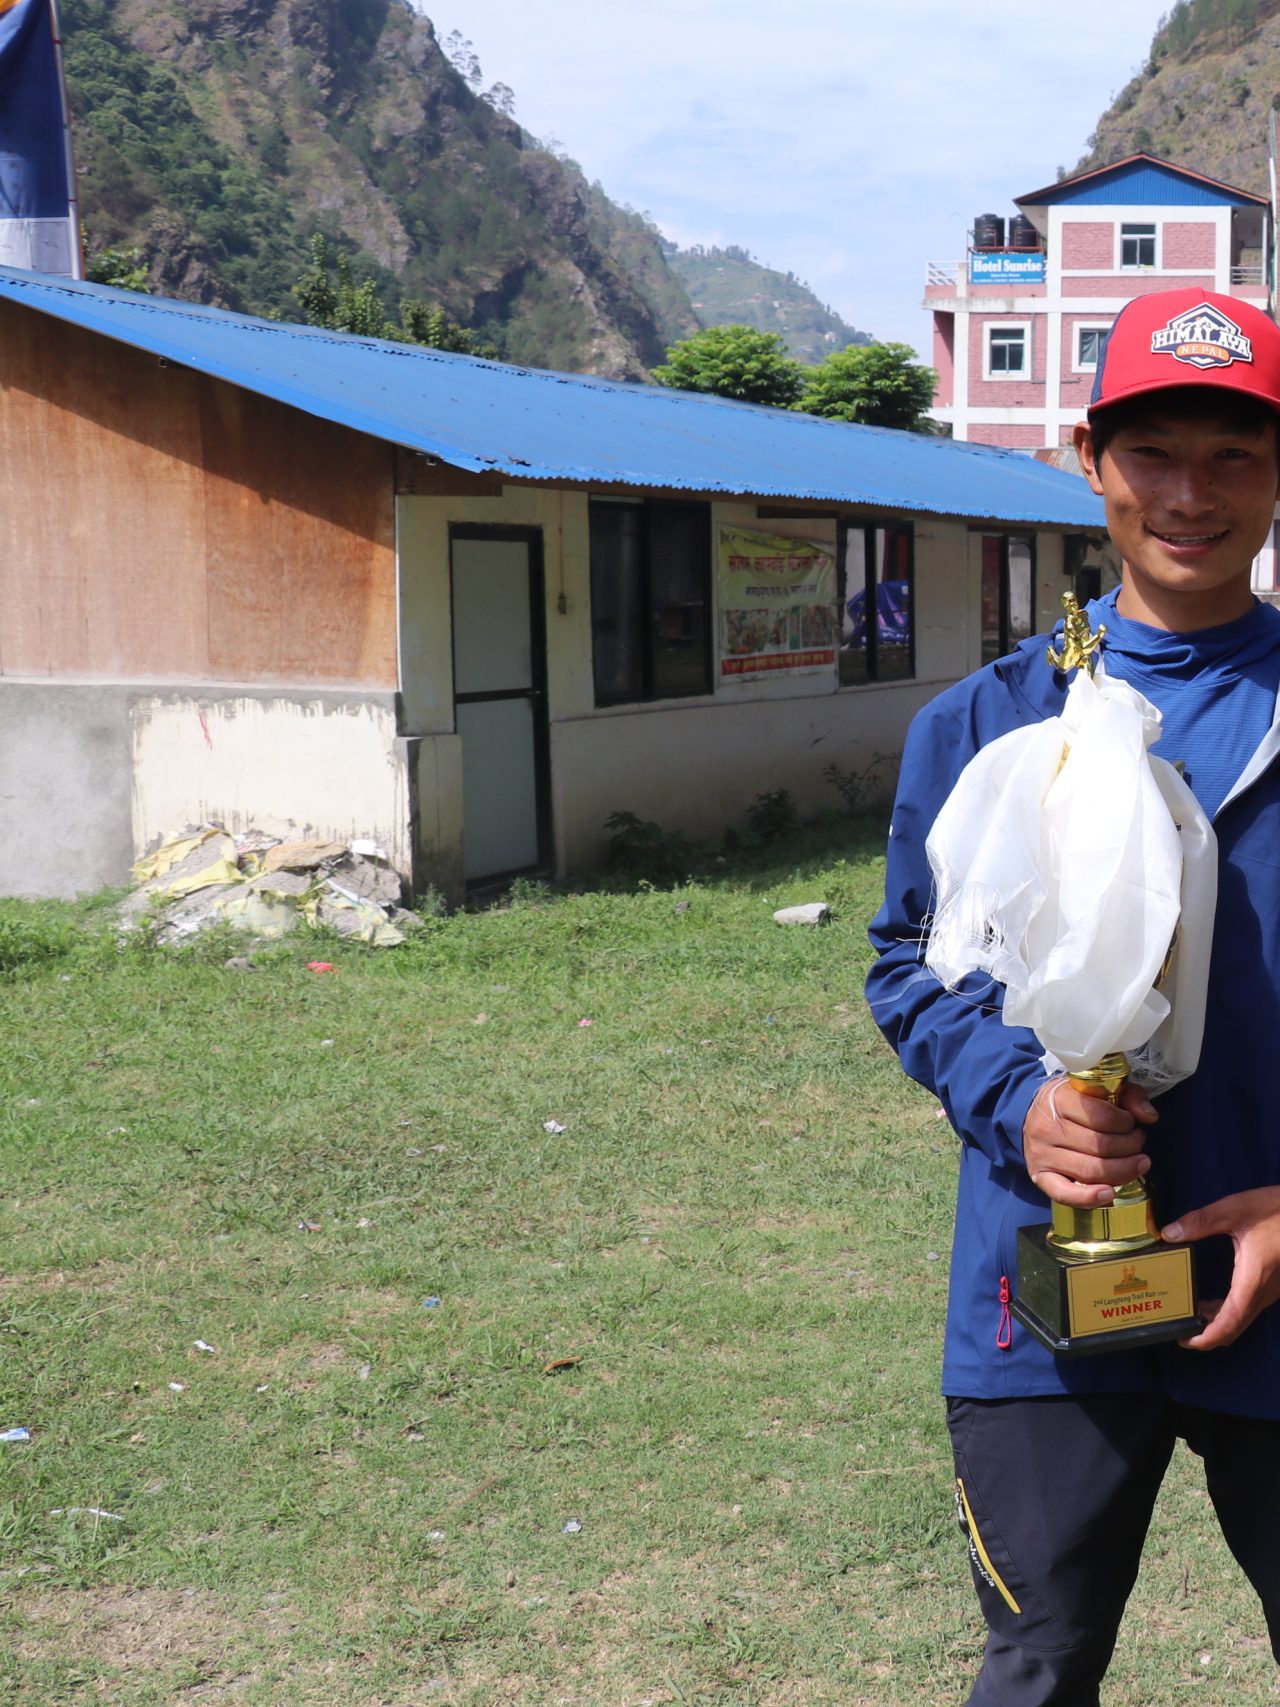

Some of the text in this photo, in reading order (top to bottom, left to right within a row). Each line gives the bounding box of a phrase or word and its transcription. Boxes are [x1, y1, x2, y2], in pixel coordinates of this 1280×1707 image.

[973, 258, 1042, 272] Hotel Sunrise
[1154, 326, 1249, 357] HIMALAYA
[1181, 345, 1224, 358] NEPAL
[1104, 1296, 1131, 1305] Langtang
[1132, 1293, 1144, 1301] Trail
[1101, 1301, 1162, 1318] WINNER
